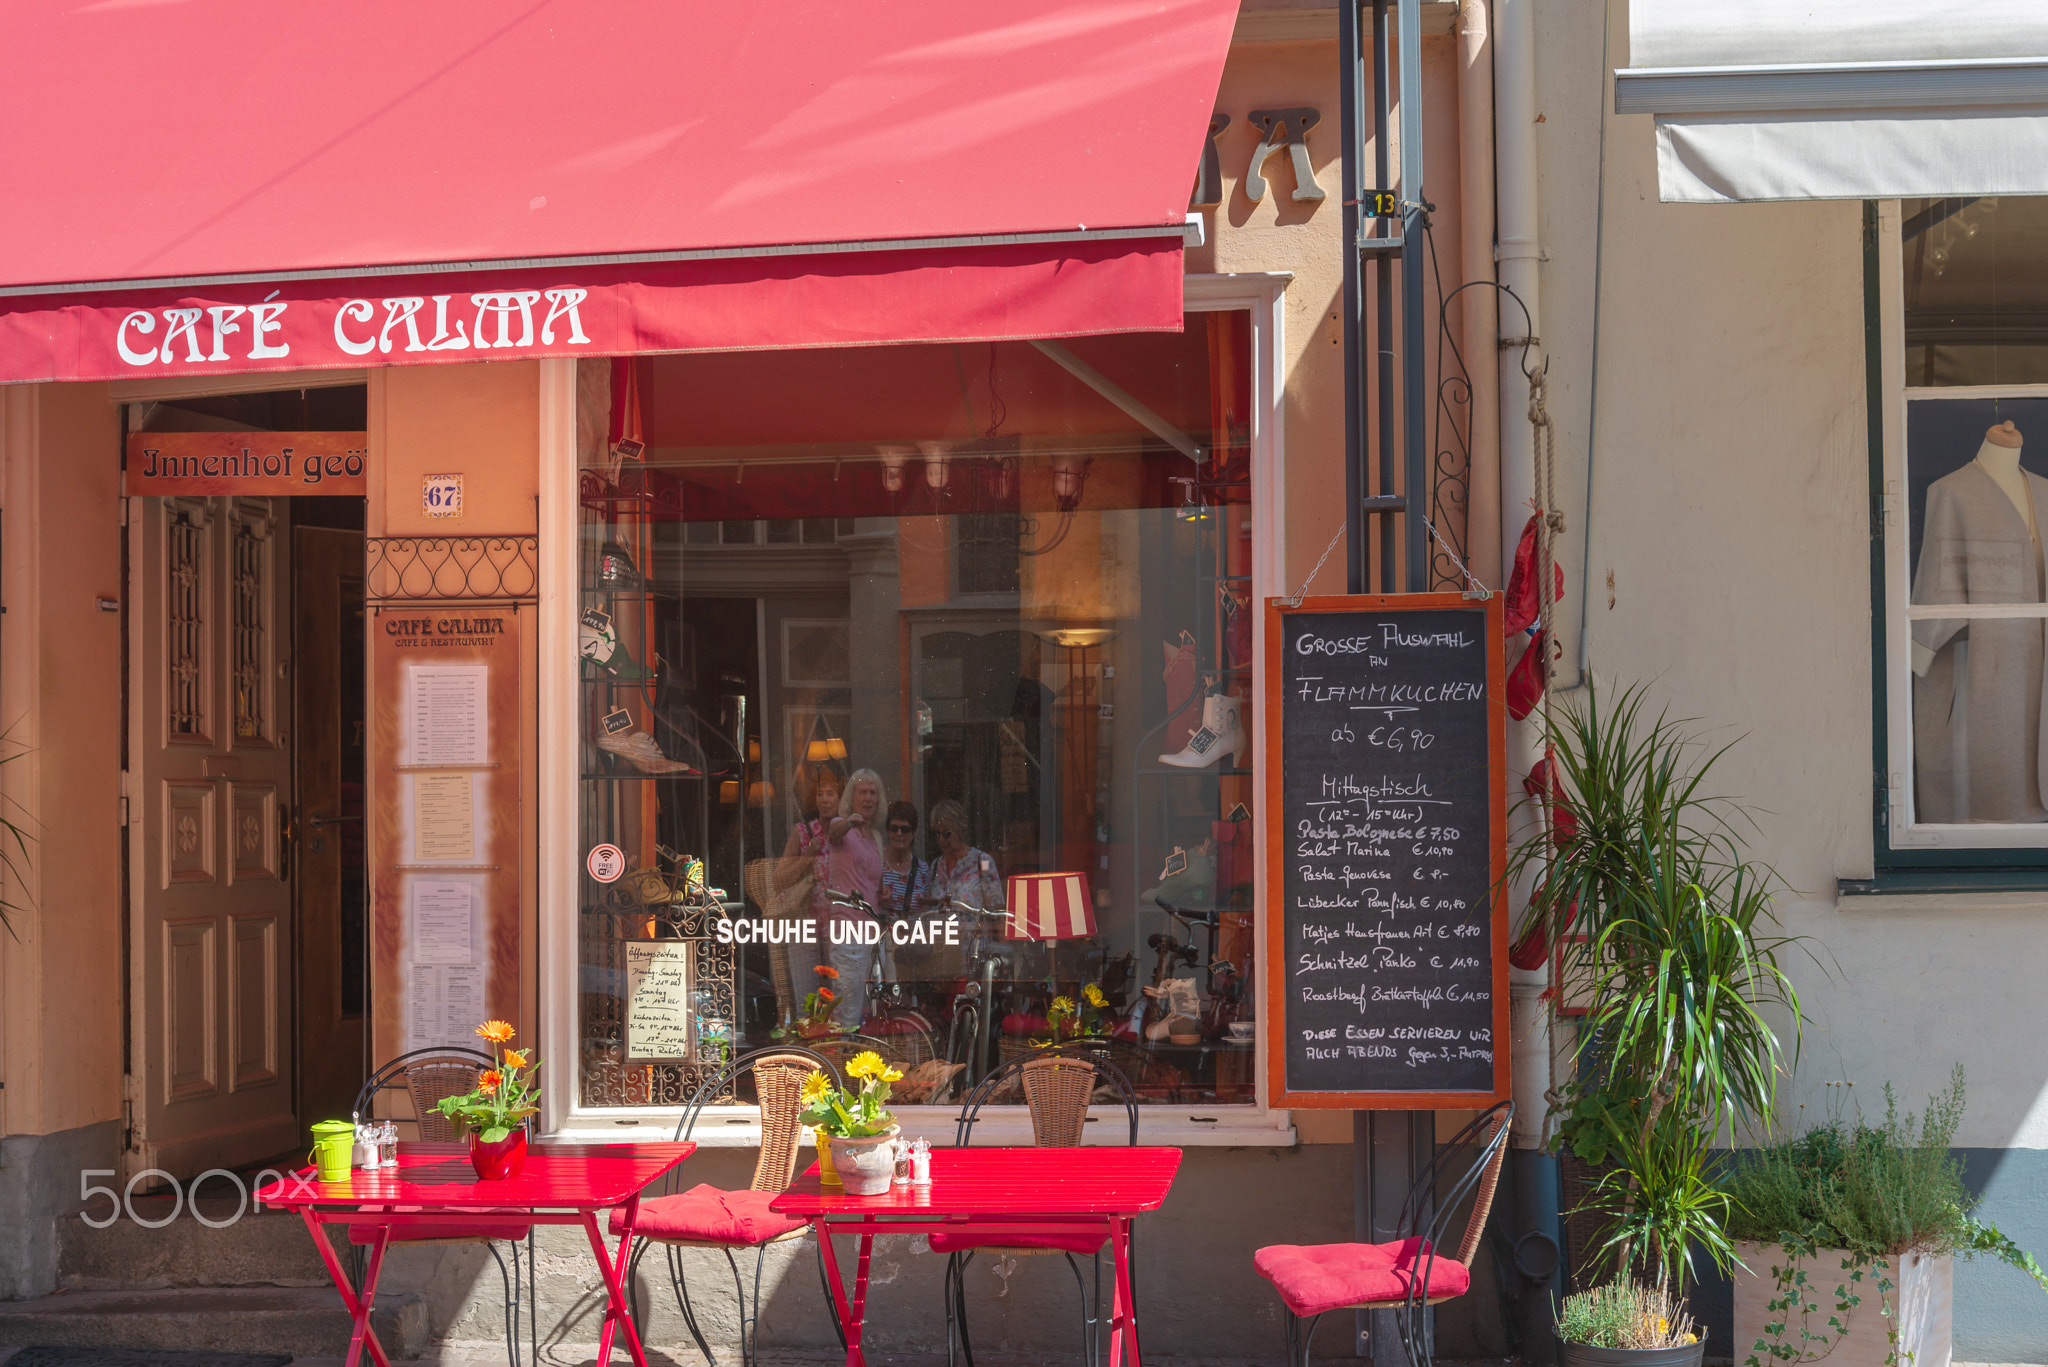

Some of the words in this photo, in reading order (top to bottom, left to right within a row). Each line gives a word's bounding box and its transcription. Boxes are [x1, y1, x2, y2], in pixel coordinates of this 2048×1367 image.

[1375, 195, 1395, 214] 13
[117, 289, 290, 365] CAFÉ
[334, 288, 591, 355] CALMA
[143, 448, 295, 478] Innenhof
[428, 486, 456, 506] 67
[386, 616, 432, 635] CAFÉ
[437, 618, 504, 634] CALMA
[430, 637, 495, 647] RESTAURANT
[1296, 633, 1371, 655] GROSSE
[1378, 623, 1475, 649] AUSWAHL
[1369, 655, 1388, 667] AN
[1296, 677, 1483, 702] FLAMMKUCHEN
[1331, 723, 1355, 743] ab
[1323, 773, 1432, 811] Mittagstisch
[1297, 819, 1340, 839] Pasta
[1342, 823, 1413, 845] Bolognese
[1297, 840, 1341, 857] Salat
[1347, 841, 1390, 857] Marina
[1299, 865, 1335, 882] Pasta
[1339, 865, 1391, 889] Genovese
[1297, 894, 1359, 908] Lübecker
[1361, 887, 1416, 919] Pannfisch
[716, 919, 817, 944] SCHUHE
[829, 920, 880, 944] UND
[892, 913, 960, 945] CAFÉ
[1303, 923, 1340, 945] Matjes
[1413, 922, 1432, 939] Art
[1296, 951, 1369, 975] Schnitzel
[1302, 984, 1366, 1013] Roastbeef
[1303, 1028, 1337, 1041] DIESE
[1346, 1025, 1385, 1040] ESSEN
[1389, 1027, 1461, 1040] SERVIEREN
[1306, 1047, 1339, 1060] AUCH
[1346, 1045, 1397, 1059] ABENDS
